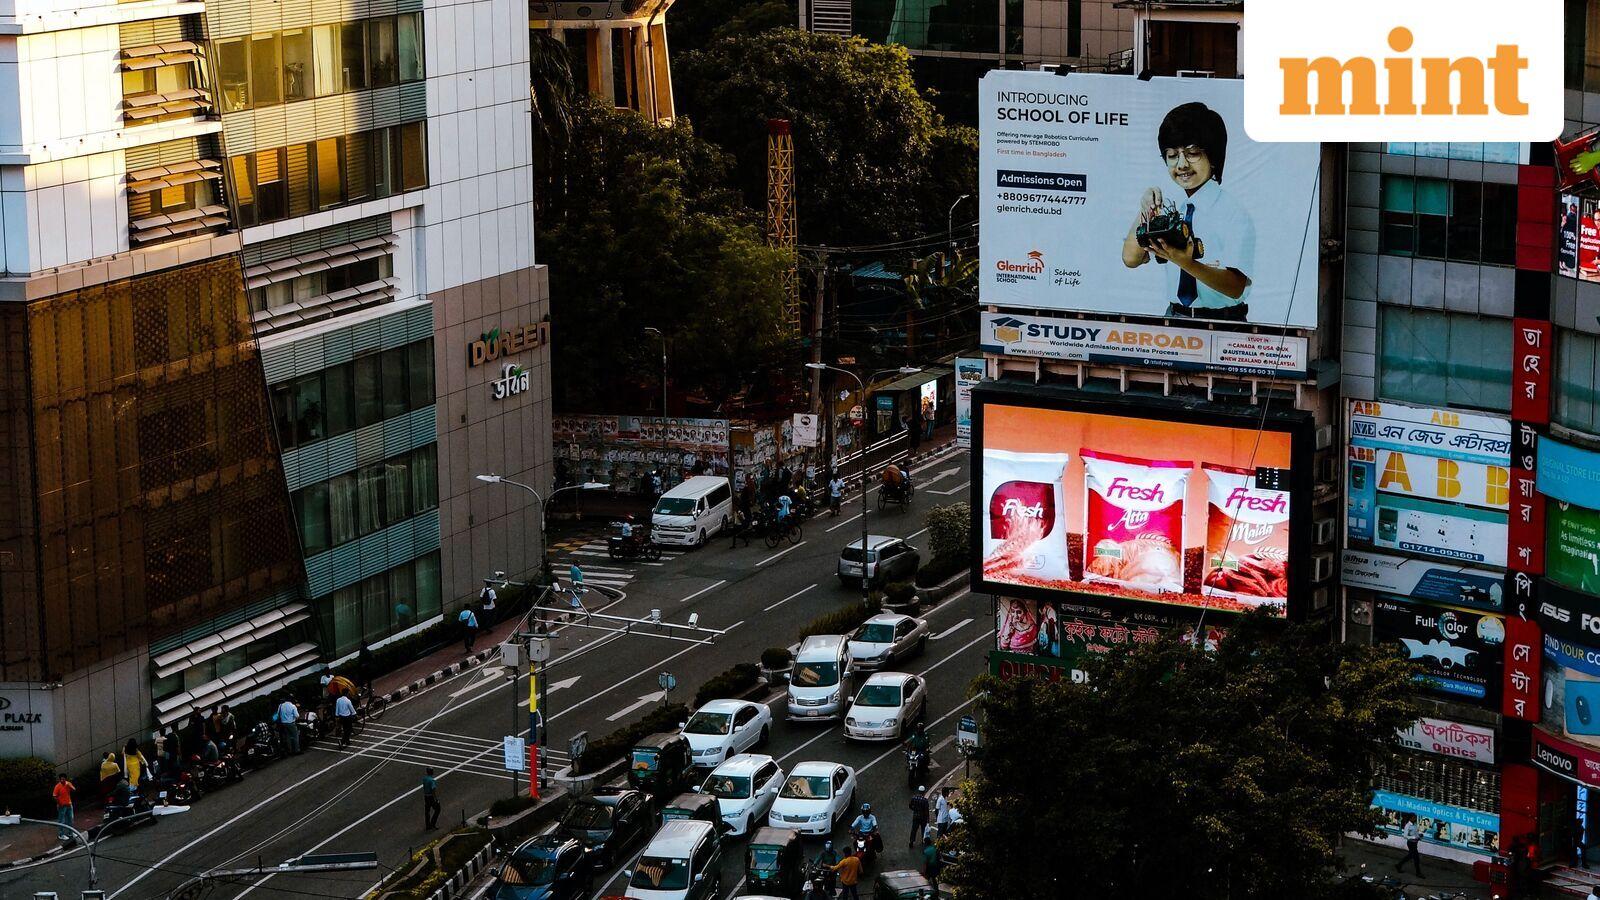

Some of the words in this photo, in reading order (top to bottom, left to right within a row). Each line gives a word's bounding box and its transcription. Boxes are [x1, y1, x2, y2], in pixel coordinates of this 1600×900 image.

[997, 91, 1088, 106] INTRODUCING
[997, 107, 1064, 123] SCHOOL
[1068, 111, 1090, 124] OF
[1095, 112, 1128, 126] LIFE
[996, 131, 1019, 139] Offering
[1020, 133, 1043, 141] new-age
[1044, 133, 1068, 141] Robotics
[1032, 150, 1067, 158] Bangladesh
[1000, 174, 1055, 185] Admissions
[1056, 177, 1083, 188] Open
[996, 192, 1087, 205] +8809677444777
[996, 204, 1062, 215] glenrich.edu.bd
[1581, 224, 1597, 236] Free
[996, 260, 1042, 273] Glenrich
[1054, 268, 1082, 277] School
[1054, 277, 1062, 286] of
[1064, 278, 1081, 287] Life
[1027, 323, 1101, 342] STUDY
[1106, 329, 1204, 350] ABROAD
[1049, 340, 1084, 349] Worldwide
[1085, 343, 1120, 351] Admission
[1151, 348, 1179, 356] Process
[1228, 349, 1258, 357] AUSTRALIA
[1353, 401, 1381, 416] ABB
[1431, 410, 1460, 427] ABB
[1378, 425, 1405, 440] এন
[1408, 430, 1446, 445] জেড
[1349, 446, 1375, 462] ABB
[1565, 464, 1587, 479] STORE
[1107, 477, 1164, 503] Fresh
[1001, 498, 1044, 519] Fresh
[1225, 487, 1287, 514] Fresh
[1231, 521, 1274, 545] Maida
[1402, 542, 1480, 560] 01714-093601
[1539, 602, 1571, 623] ASUS
[1544, 633, 1559, 652] FIND
[1559, 643, 1585, 663] YOUR
[4, 712, 42, 724] PLAZA
[1432, 742, 1477, 759] Optics
[1537, 743, 1572, 771] Lenovo
[1397, 798, 1431, 813] Al-Madina
[1432, 804, 1454, 818] Optics
[1462, 813, 1475, 824] Eye
[1476, 816, 1492, 826] Care
